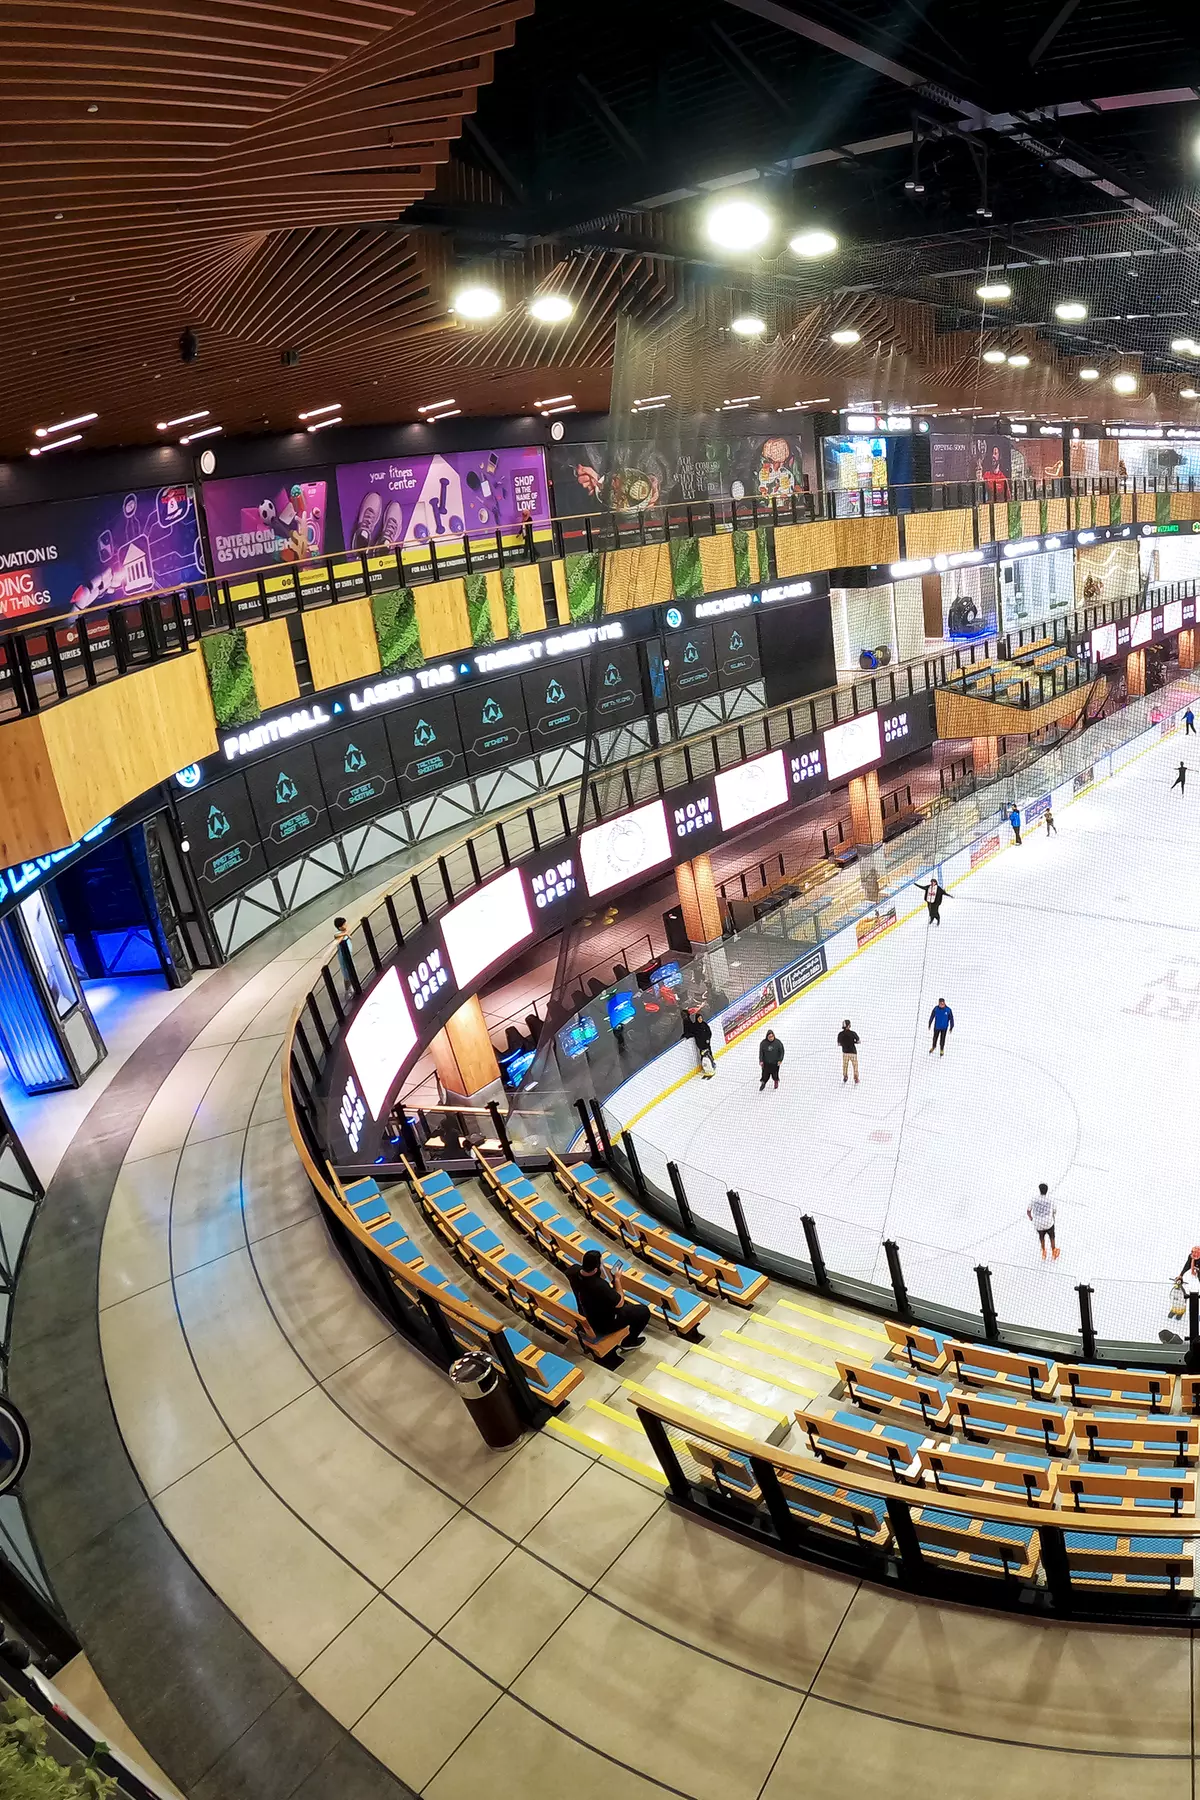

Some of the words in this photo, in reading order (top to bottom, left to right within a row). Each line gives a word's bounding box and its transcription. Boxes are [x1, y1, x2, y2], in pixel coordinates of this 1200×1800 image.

[370, 470, 386, 482] your
[389, 466, 413, 480] fitness
[388, 478, 416, 490] center
[514, 476, 534, 487] SHOP
[517, 500, 536, 512] LOVE
[531, 492, 538, 500] OF
[46, 546, 58, 560] IS
[234, 544, 264, 559] YOUR
[264, 538, 292, 555] WISH
[10, 590, 51, 610] THINGS
[224, 706, 330, 760] PAINTBALL
[350, 676, 414, 712] LASER
[416, 664, 456, 688] TAG
[474, 642, 543, 673] TARGET
[884, 712, 908, 732] NOW
[885, 724, 908, 742] OPEN
[791, 750, 820, 772] NOW
[792, 762, 822, 783] OPEN
[674, 796, 710, 824] NOW
[677, 814, 714, 837] OPEN
[532, 859, 573, 893] NOW
[535, 878, 576, 909] OPEN
[406, 948, 442, 994] NOW
[413, 968, 448, 1010] OPEN
[727, 1003, 776, 1040] LEADERSPORTS.COM
